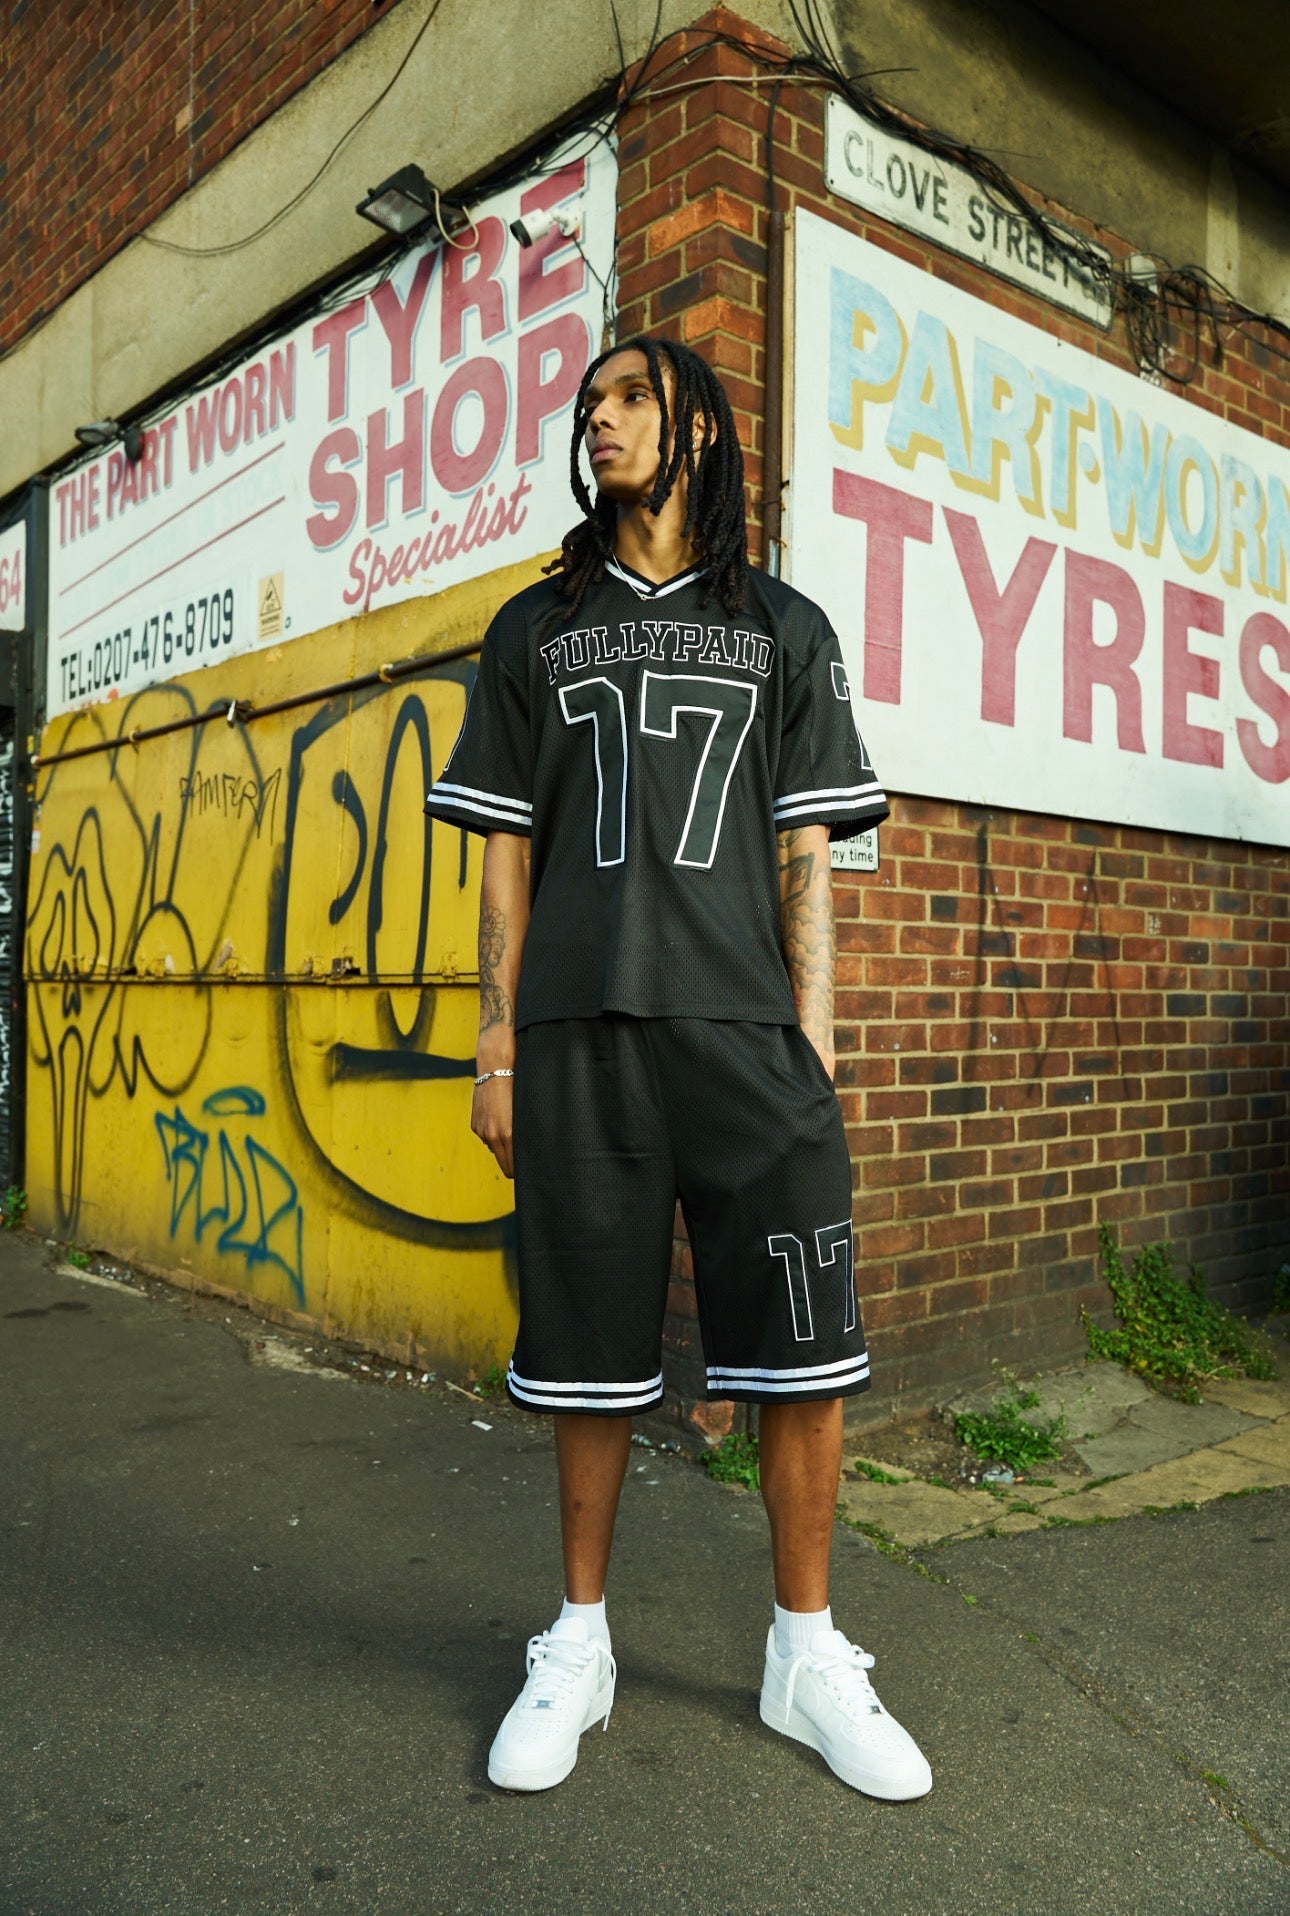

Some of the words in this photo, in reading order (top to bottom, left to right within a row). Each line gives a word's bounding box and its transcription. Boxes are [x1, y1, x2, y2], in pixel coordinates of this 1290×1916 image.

[843, 129, 949, 226] CLOVE
[312, 156, 588, 424] TYRE
[56, 464, 100, 548] THE
[106, 415, 178, 521] PART
[186, 340, 296, 474] WORN
[306, 312, 590, 550] SHOP
[342, 472, 532, 613] Specialist
[833, 467, 1290, 784] TYRES
[540, 621, 776, 686] FULLYPAID
[557, 669, 758, 869] 17
[831, 850, 845, 862] ny
[849, 848, 874, 862] time
[767, 1218, 857, 1342] 17
